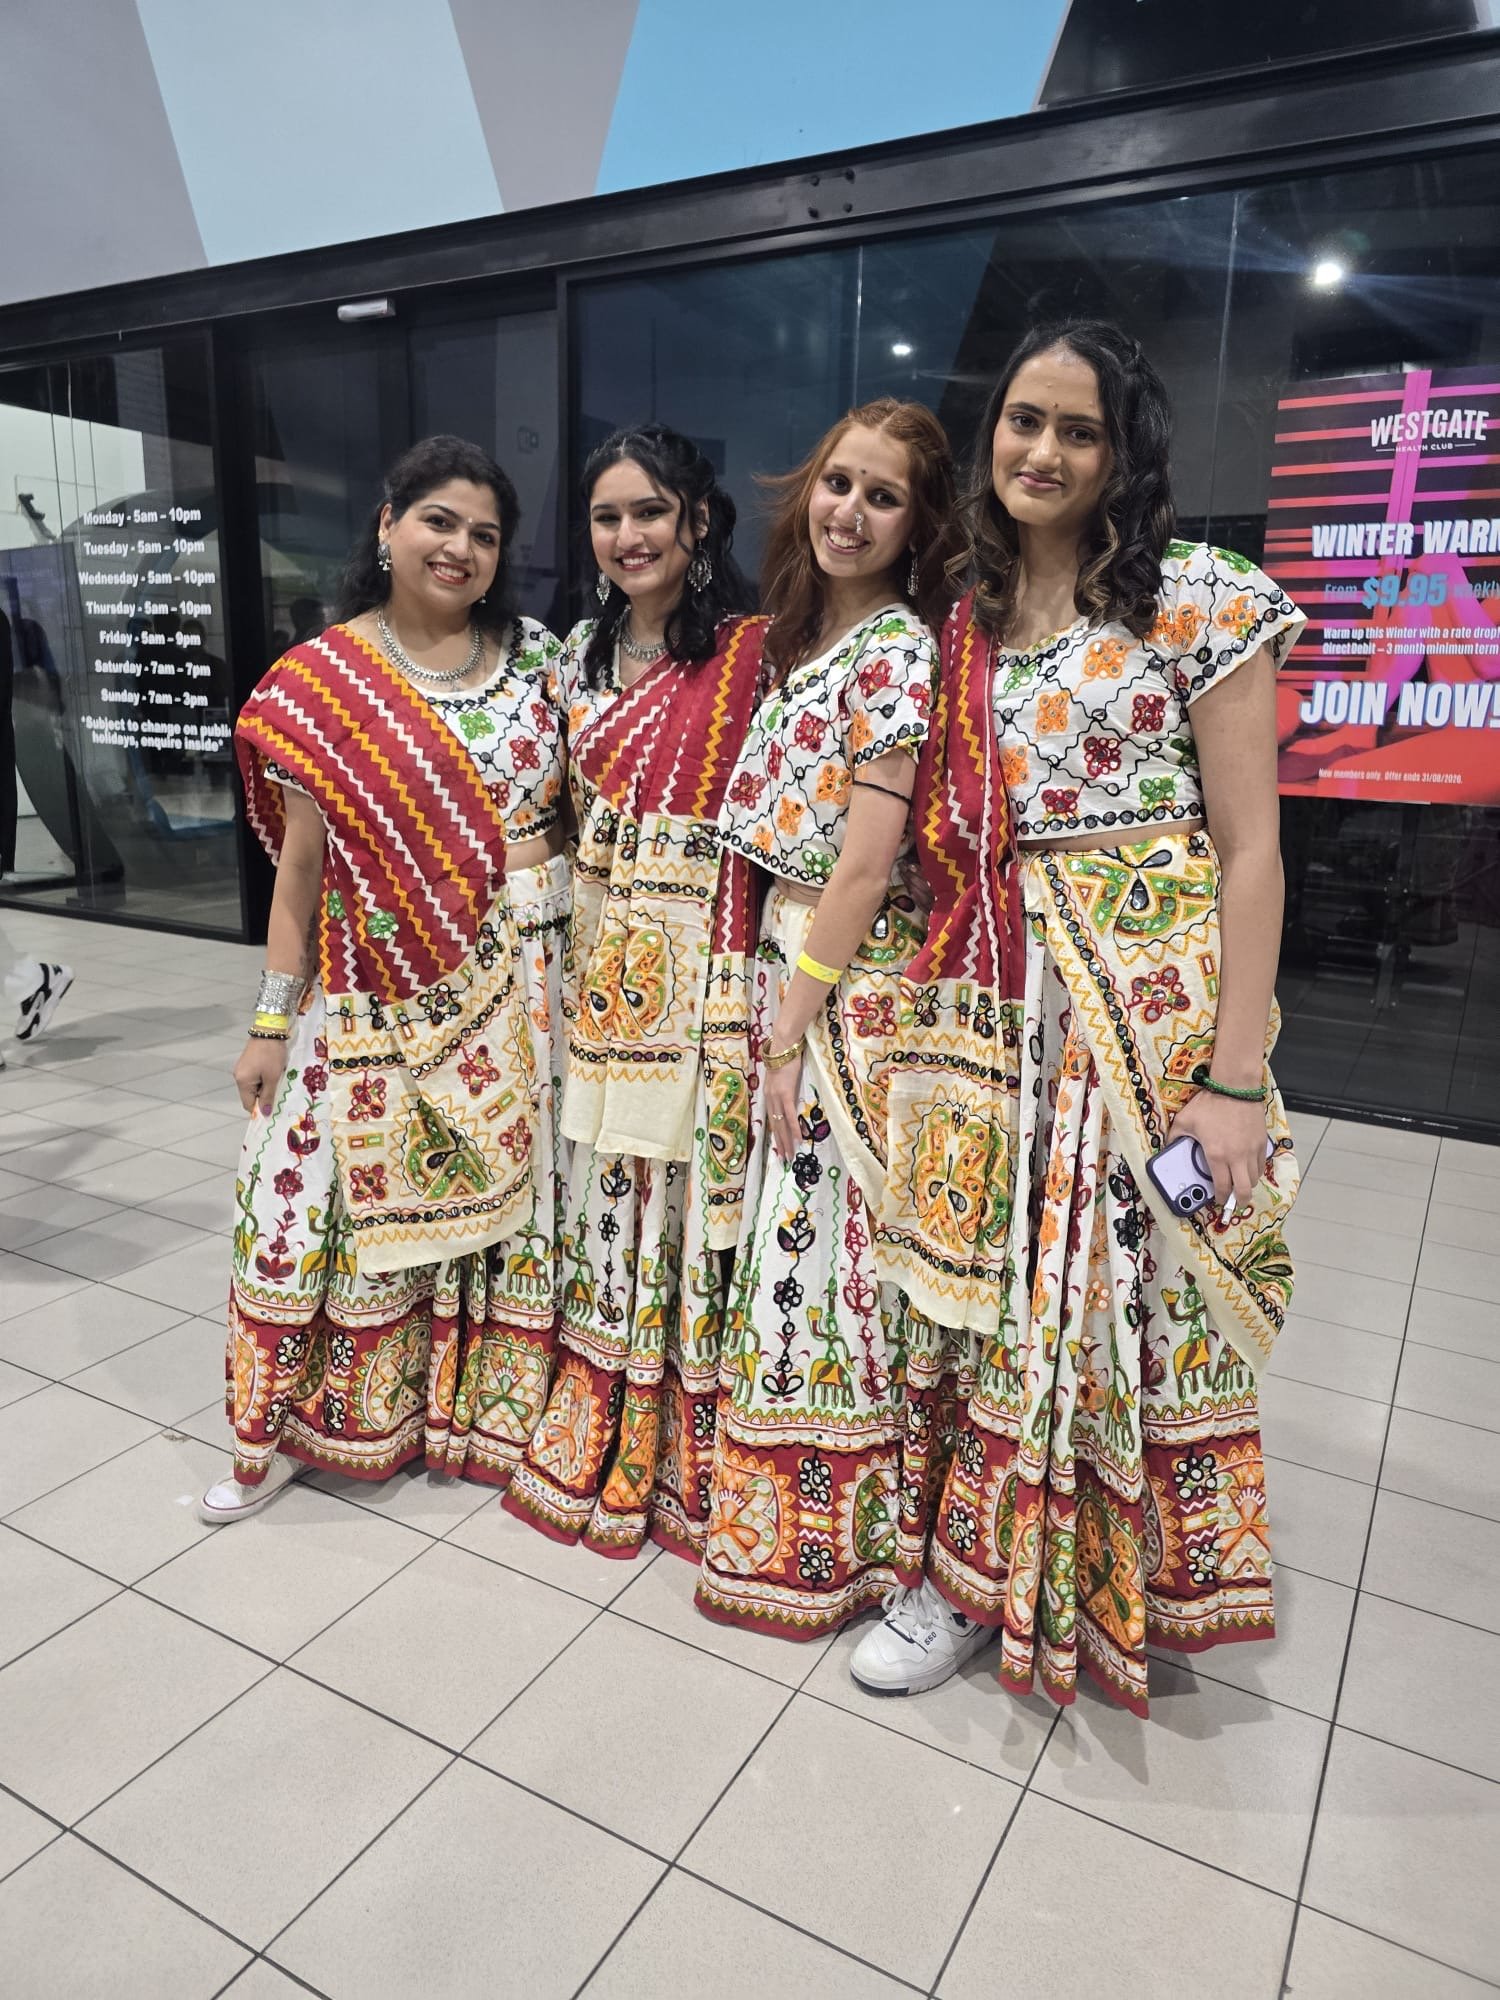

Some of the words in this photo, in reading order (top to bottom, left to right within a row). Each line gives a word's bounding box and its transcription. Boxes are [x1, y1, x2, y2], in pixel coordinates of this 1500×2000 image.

[1371, 409, 1489, 447] WESTGATE
[1396, 444, 1428, 452] HEALTH
[84, 511, 124, 527] Monday
[134, 511, 157, 524] 5am
[169, 507, 201, 524] 10pm
[84, 542, 128, 557] Tuesday
[137, 540, 162, 554] 5am
[173, 538, 205, 555] 10pm
[1312, 522, 1415, 558] WINTER
[79, 571, 139, 587] Wednesday
[148, 571, 172, 584] 5am
[183, 570, 216, 587] 10pm
[1324, 584, 1357, 600] From
[1362, 573, 1448, 609] $9.95
[86, 601, 135, 618] Thursday
[143, 601, 168, 615] 5am
[179, 600, 212, 618] 10pm
[99, 630, 132, 647] Friday
[141, 631, 165, 645] 5am
[175, 631, 201, 648] 9pm
[1323, 627, 1350, 639] Warm
[1351, 629, 1365, 641] up
[1365, 627, 1384, 639] this
[1386, 627, 1418, 639] Winter
[1419, 626, 1441, 639] with
[1442, 629, 1449, 639] a
[1451, 627, 1472, 639] rate
[1322, 642, 1350, 655] Direct
[1350, 642, 1376, 655] Debit
[1386, 643, 1393, 655] 3
[1394, 643, 1426, 655] month
[1426, 643, 1474, 655] minimum
[1474, 642, 1499, 655] term
[94, 659, 142, 677] Saturday
[150, 661, 175, 675] 7am
[186, 662, 211, 679] 7pm
[101, 688, 140, 706] Sunday
[148, 691, 173, 705] 7am
[183, 692, 208, 708] 3pm
[1300, 680, 1388, 726] JOIN
[127, 718, 139, 732] to
[140, 720, 181, 737] change
[183, 724, 198, 736] on
[92, 730, 139, 748] holidays,
[140, 735, 182, 751] enquire
